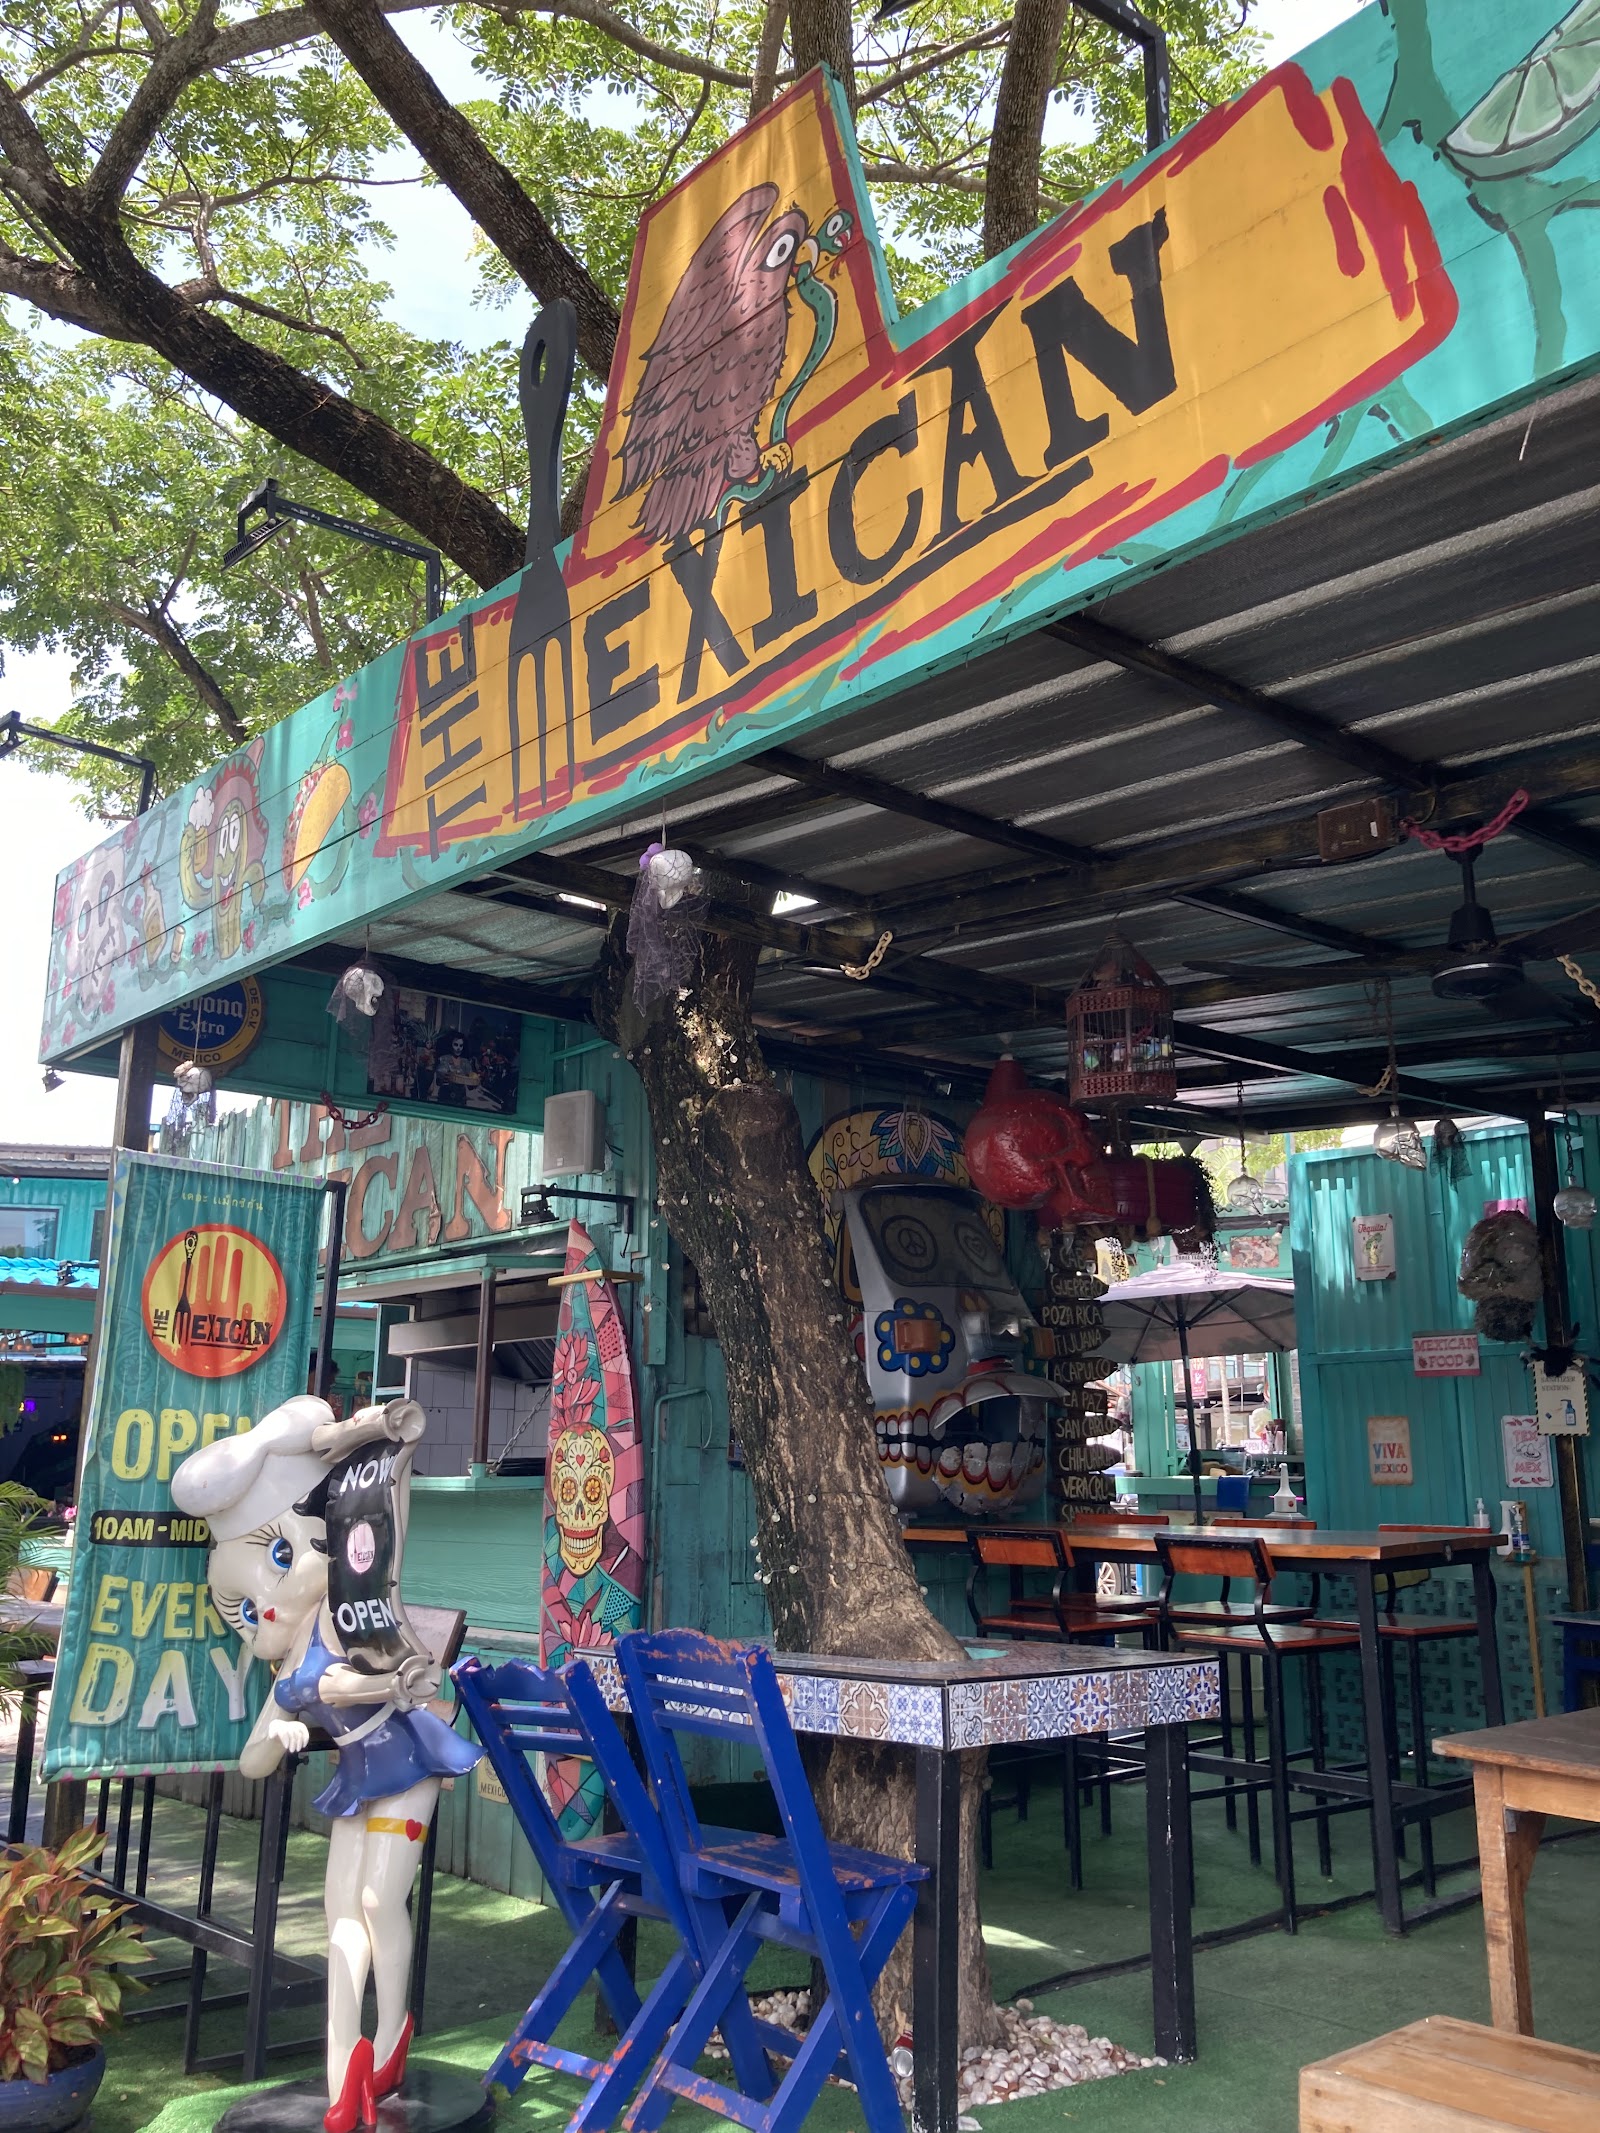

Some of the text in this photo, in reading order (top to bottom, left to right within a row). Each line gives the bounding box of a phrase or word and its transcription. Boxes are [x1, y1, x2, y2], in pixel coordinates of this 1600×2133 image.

[414, 206, 1177, 862] THE MEXICAN
[166, 995, 244, 1019] orona
[178, 1013, 225, 1036] Extra
[171, 1047, 221, 1063] MEXICO
[1050, 1273, 1104, 1298] GUERRERO
[152, 1302, 273, 1346] THE MEXICAN
[1042, 1304, 1103, 1326] POZA RICA
[1053, 1328, 1103, 1357] TIJUANA
[1414, 1338, 1478, 1352] MEXICAN
[1053, 1359, 1111, 1384] ACAPULCO
[1428, 1353, 1463, 1368] FOOD
[1081, 1391, 1104, 1409] PAZ
[1055, 1415, 1119, 1440] SAN CARLOS
[1512, 1429, 1538, 1441] TEX
[112, 1409, 253, 1482] OP
[1373, 1443, 1406, 1459] VIVA
[1059, 1447, 1116, 1472] CHIHUAHUA
[1514, 1461, 1543, 1473] MEX
[339, 1455, 397, 1493] NOW
[170, 1519, 211, 1542] MID
[90, 1574, 228, 1640] EVER
[337, 1598, 397, 1632] OPEN
[69, 1642, 255, 1730] DAY
